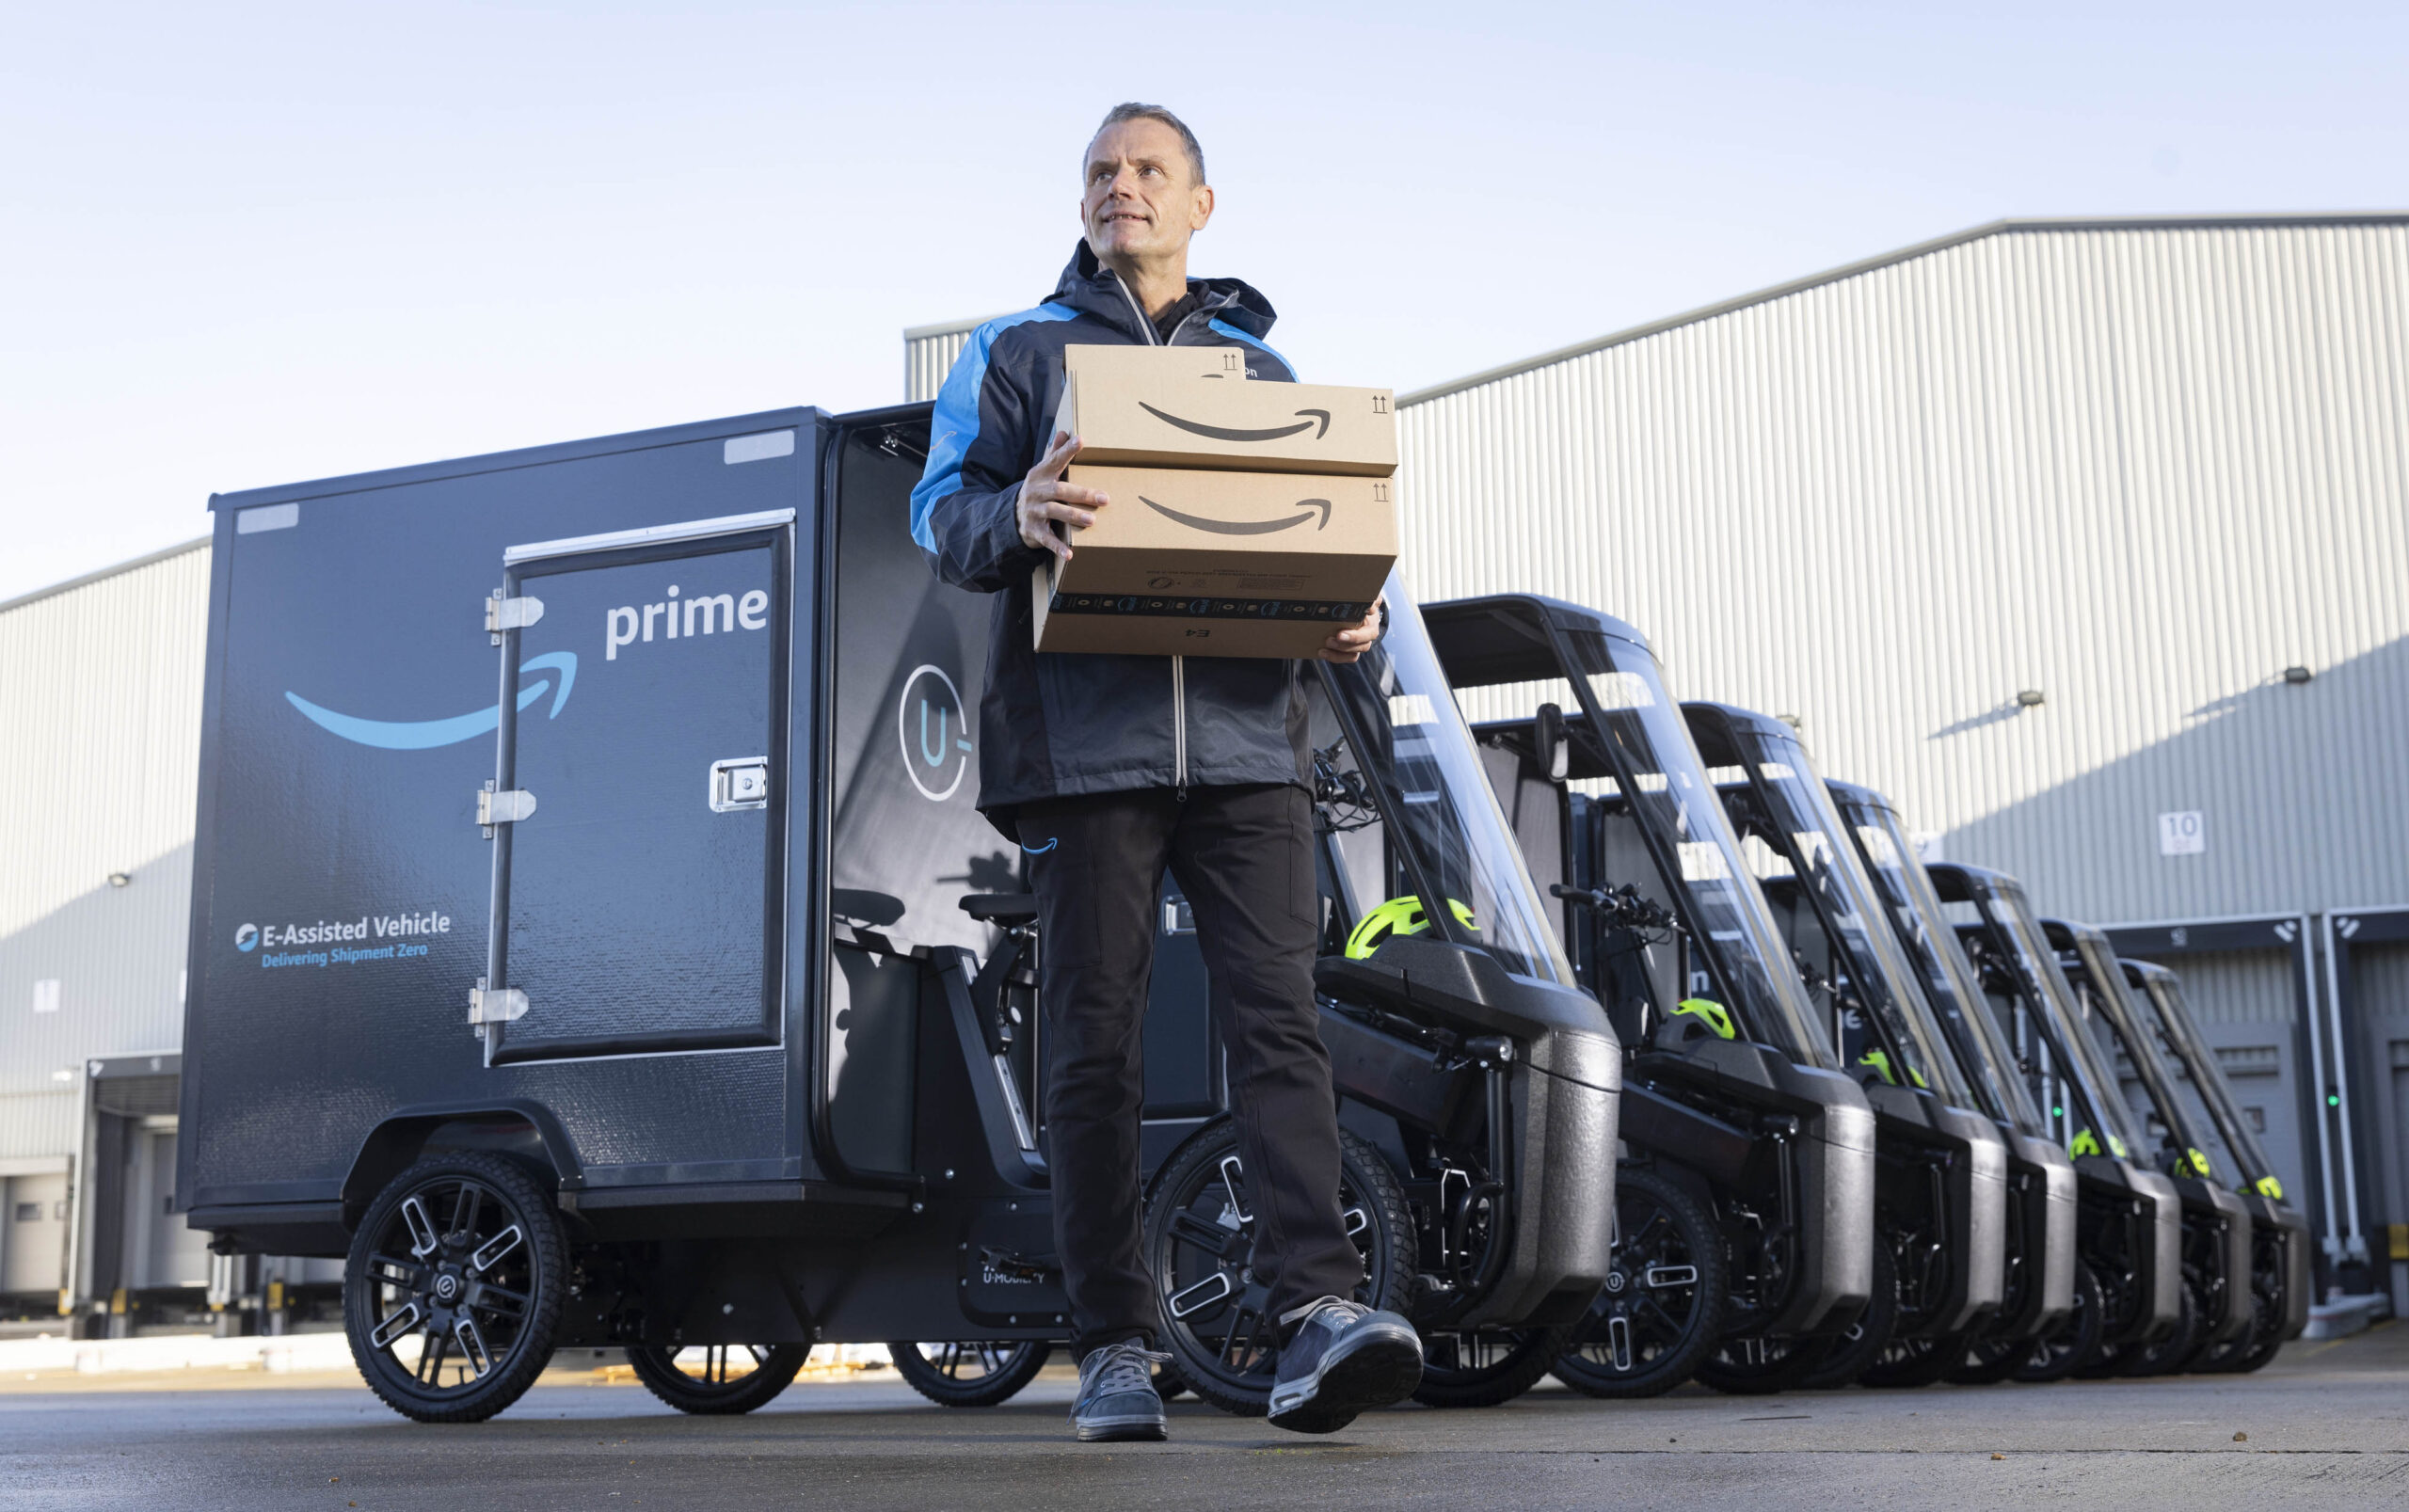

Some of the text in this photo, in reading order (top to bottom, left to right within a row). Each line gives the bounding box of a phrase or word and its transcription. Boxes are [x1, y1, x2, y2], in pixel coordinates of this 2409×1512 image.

[606, 584, 768, 661] prime
[2169, 815, 2197, 836] 10
[263, 911, 450, 947] E-Assisted Vehicle
[262, 944, 427, 967] Delivering Shipment Zero
